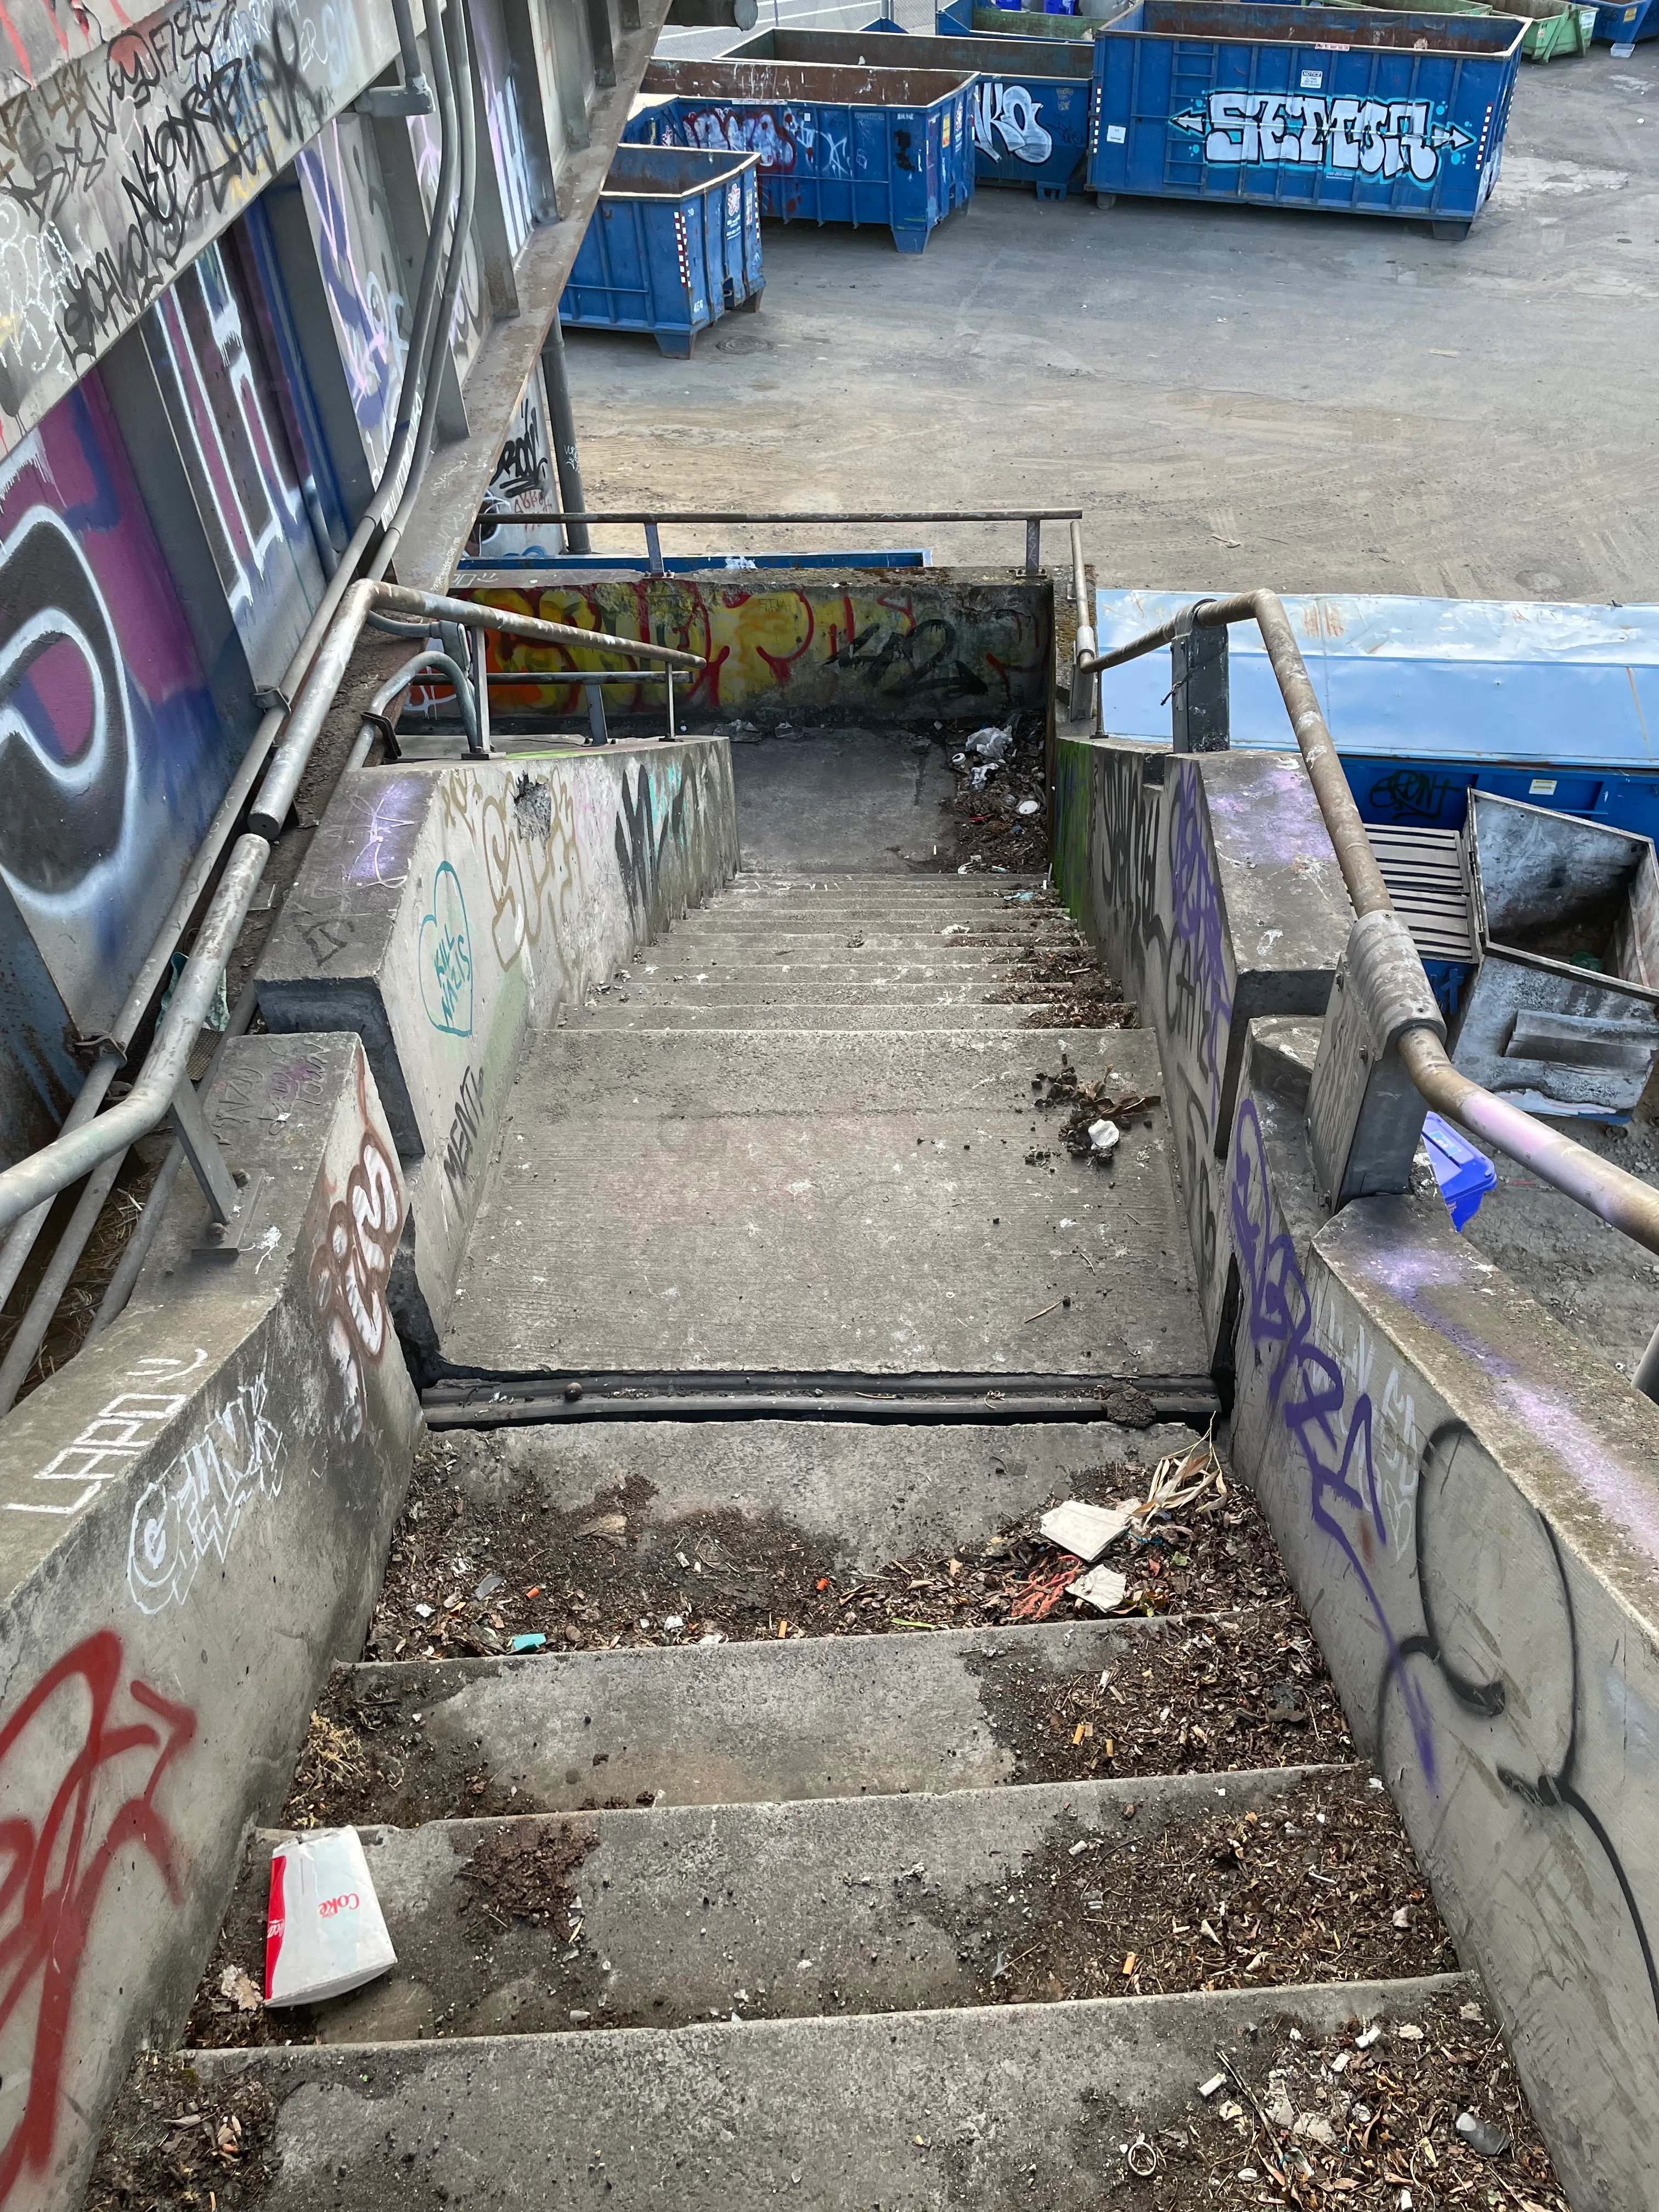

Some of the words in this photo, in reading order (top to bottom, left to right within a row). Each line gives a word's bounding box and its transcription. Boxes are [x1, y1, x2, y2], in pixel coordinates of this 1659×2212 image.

[434, 923, 455, 983] KILL
[441, 935, 471, 1029] NAZIS
[318, 1893, 360, 1917] Coke
